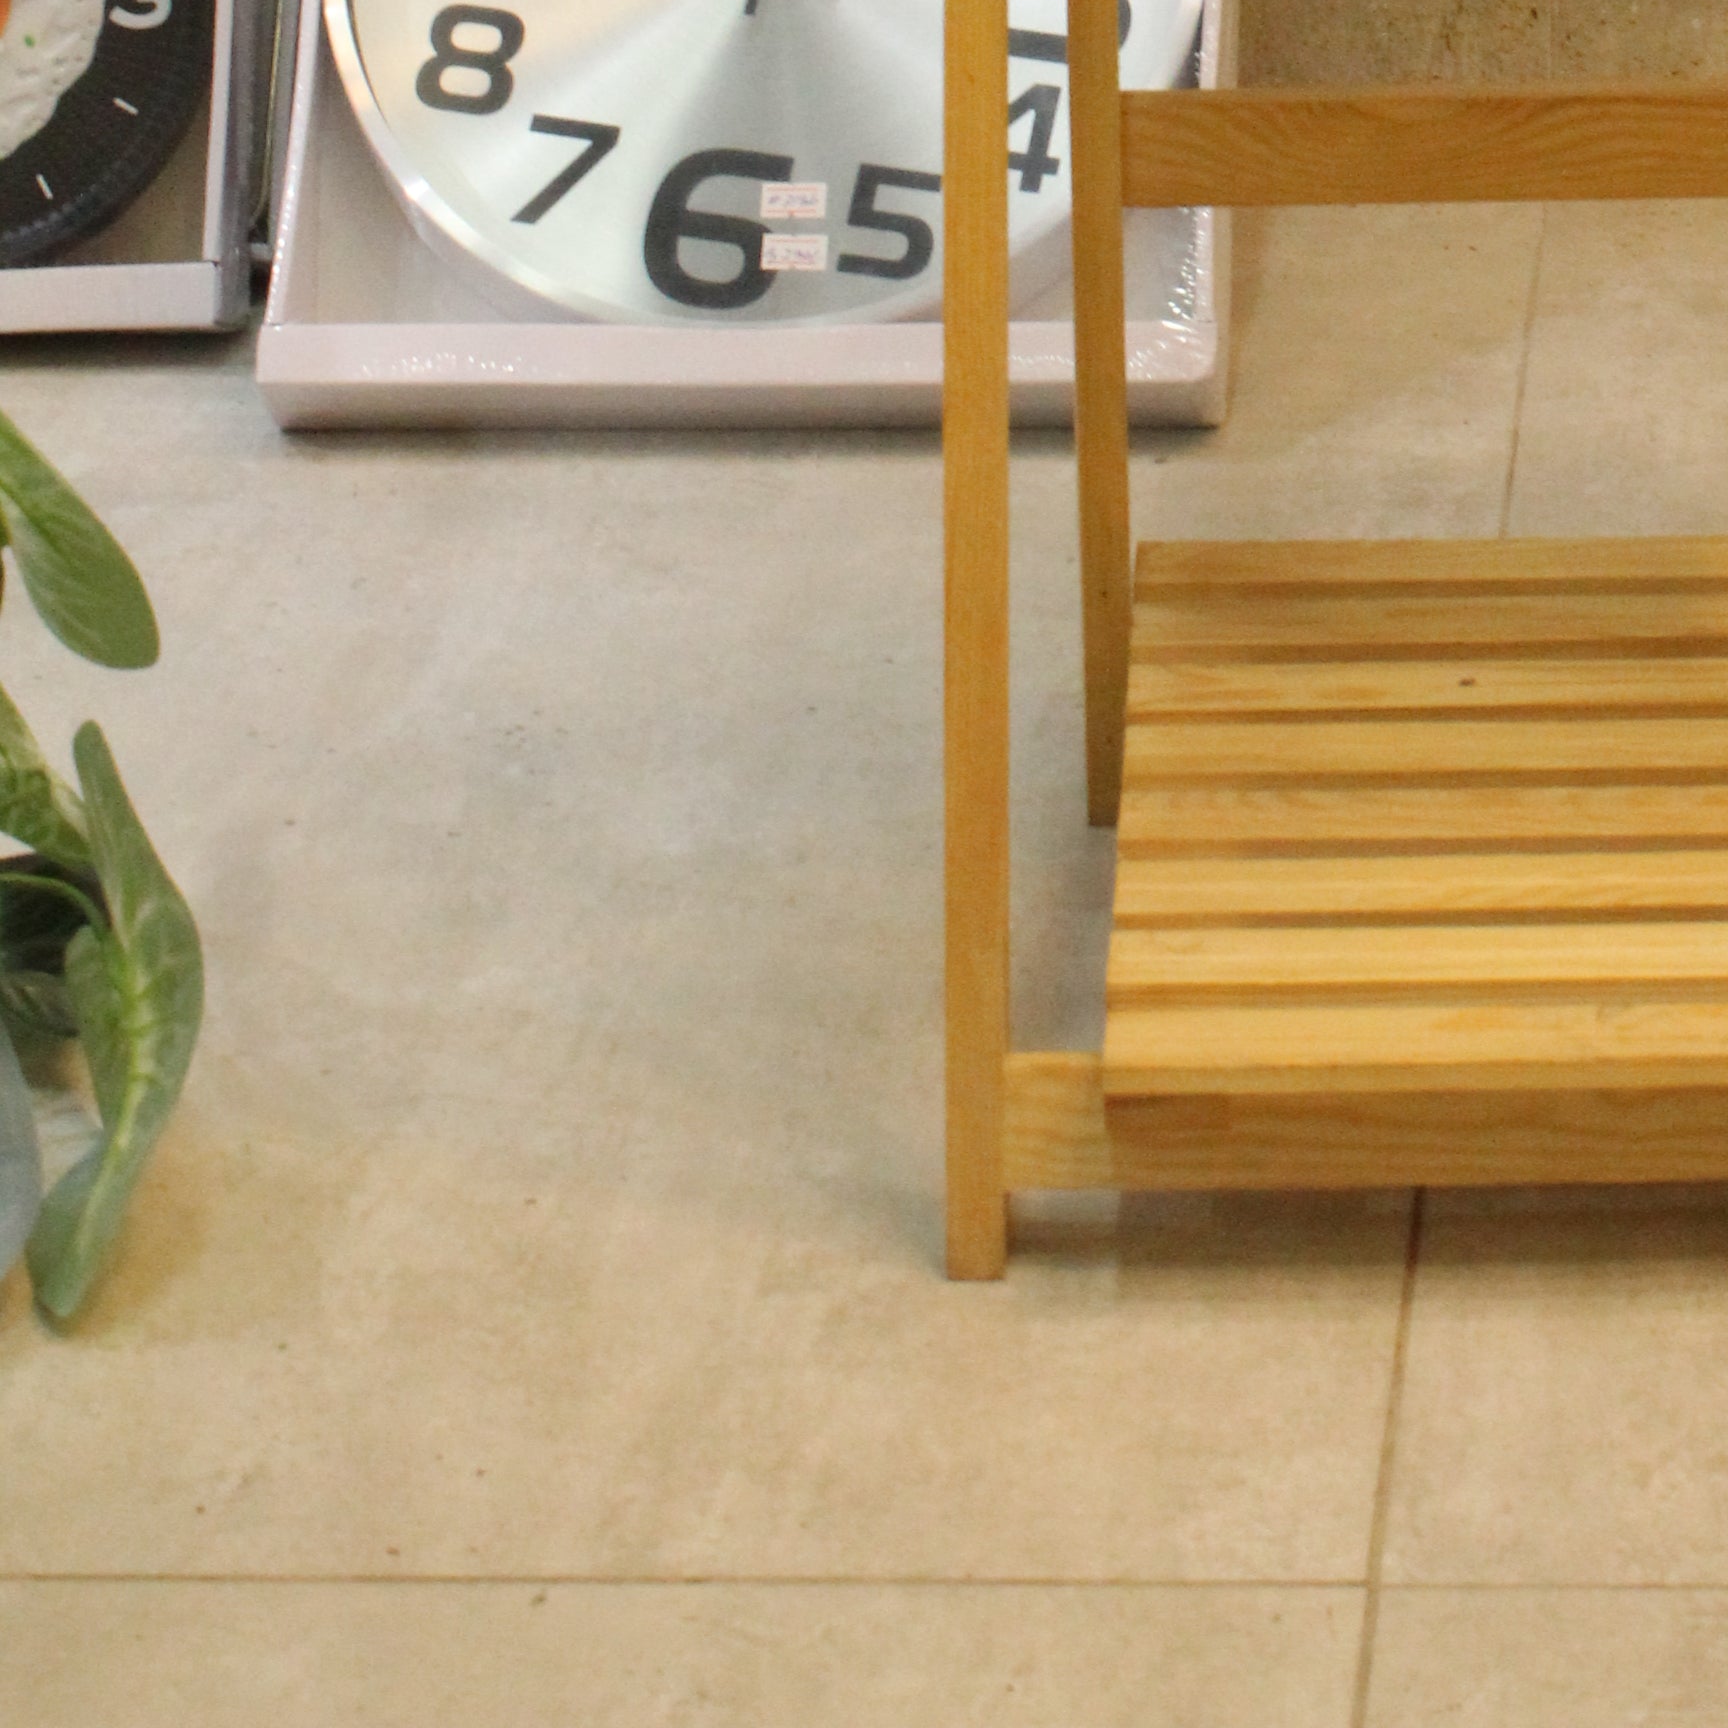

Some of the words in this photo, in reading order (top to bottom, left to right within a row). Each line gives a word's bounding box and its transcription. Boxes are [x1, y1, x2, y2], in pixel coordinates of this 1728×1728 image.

[413, 4, 526, 116] 8
[510, 114, 622, 226] 7
[836, 162, 943, 282] 5
[642, 147, 795, 311] 6
